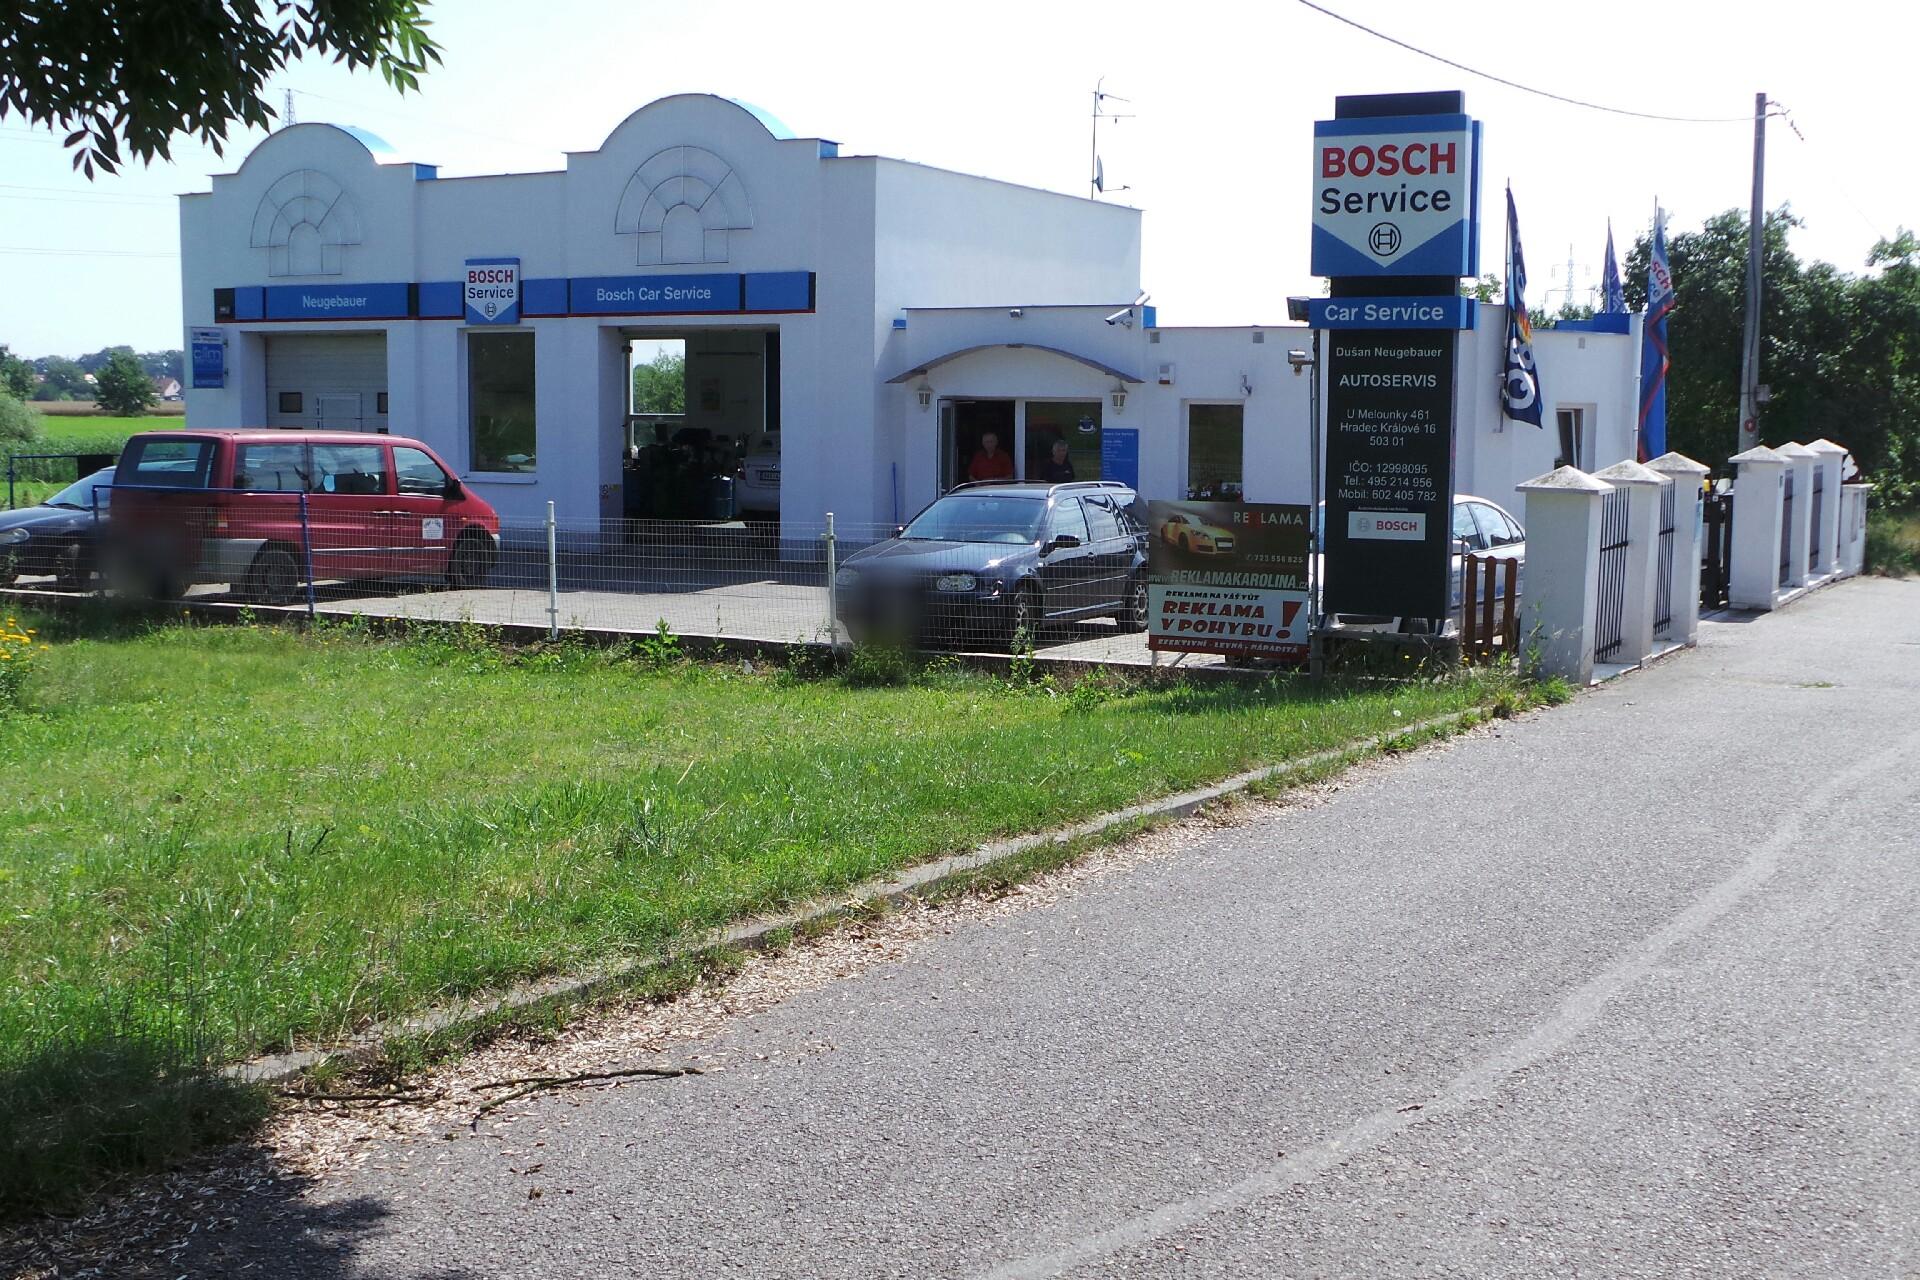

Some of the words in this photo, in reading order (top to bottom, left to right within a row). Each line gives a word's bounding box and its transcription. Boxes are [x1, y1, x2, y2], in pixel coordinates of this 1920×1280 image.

[1322, 143, 1456, 178] BOSCH
[1320, 184, 1451, 214] Service
[468, 270, 514, 284] BOSCH
[468, 286, 514, 299] Service
[597, 288, 635, 301] Bosch
[639, 287, 661, 300] Car
[664, 286, 711, 300] Service
[302, 295, 367, 309] Neugebauer
[1325, 304, 1358, 321] Car
[1364, 302, 1444, 320] Service
[1336, 347, 1371, 357] Dušan
[1374, 347, 1443, 359] Neugebauer
[1339, 374, 1437, 388] AUTOSERVIS
[1347, 409, 1355, 419] U
[1358, 409, 1408, 421] Melounky
[1410, 410, 1430, 420] 461
[1340, 422, 1377, 433] Hradec
[1380, 422, 1420, 433] Králové
[1424, 423, 1436, 434] 16
[1369, 436, 1389, 446] 503
[1392, 436, 1404, 446] 01
[1349, 460, 1372, 473] IČO:
[1376, 463, 1428, 474] 12998095
[1367, 476, 1387, 487] 495
[1390, 476, 1409, 487] 214
[1412, 477, 1432, 488] 956
[1372, 489, 1391, 500] 602
[1394, 490, 1414, 501] 405
[1417, 491, 1437, 502] 782
[1376, 520, 1417, 531] BOSCH
[1166, 590, 1208, 599] REKLAMA
[1209, 591, 1221, 599] NA
[1162, 600, 1265, 619] REKLAMA
[1161, 618, 1175, 630] V
[1178, 619, 1273, 639] POHYBU
